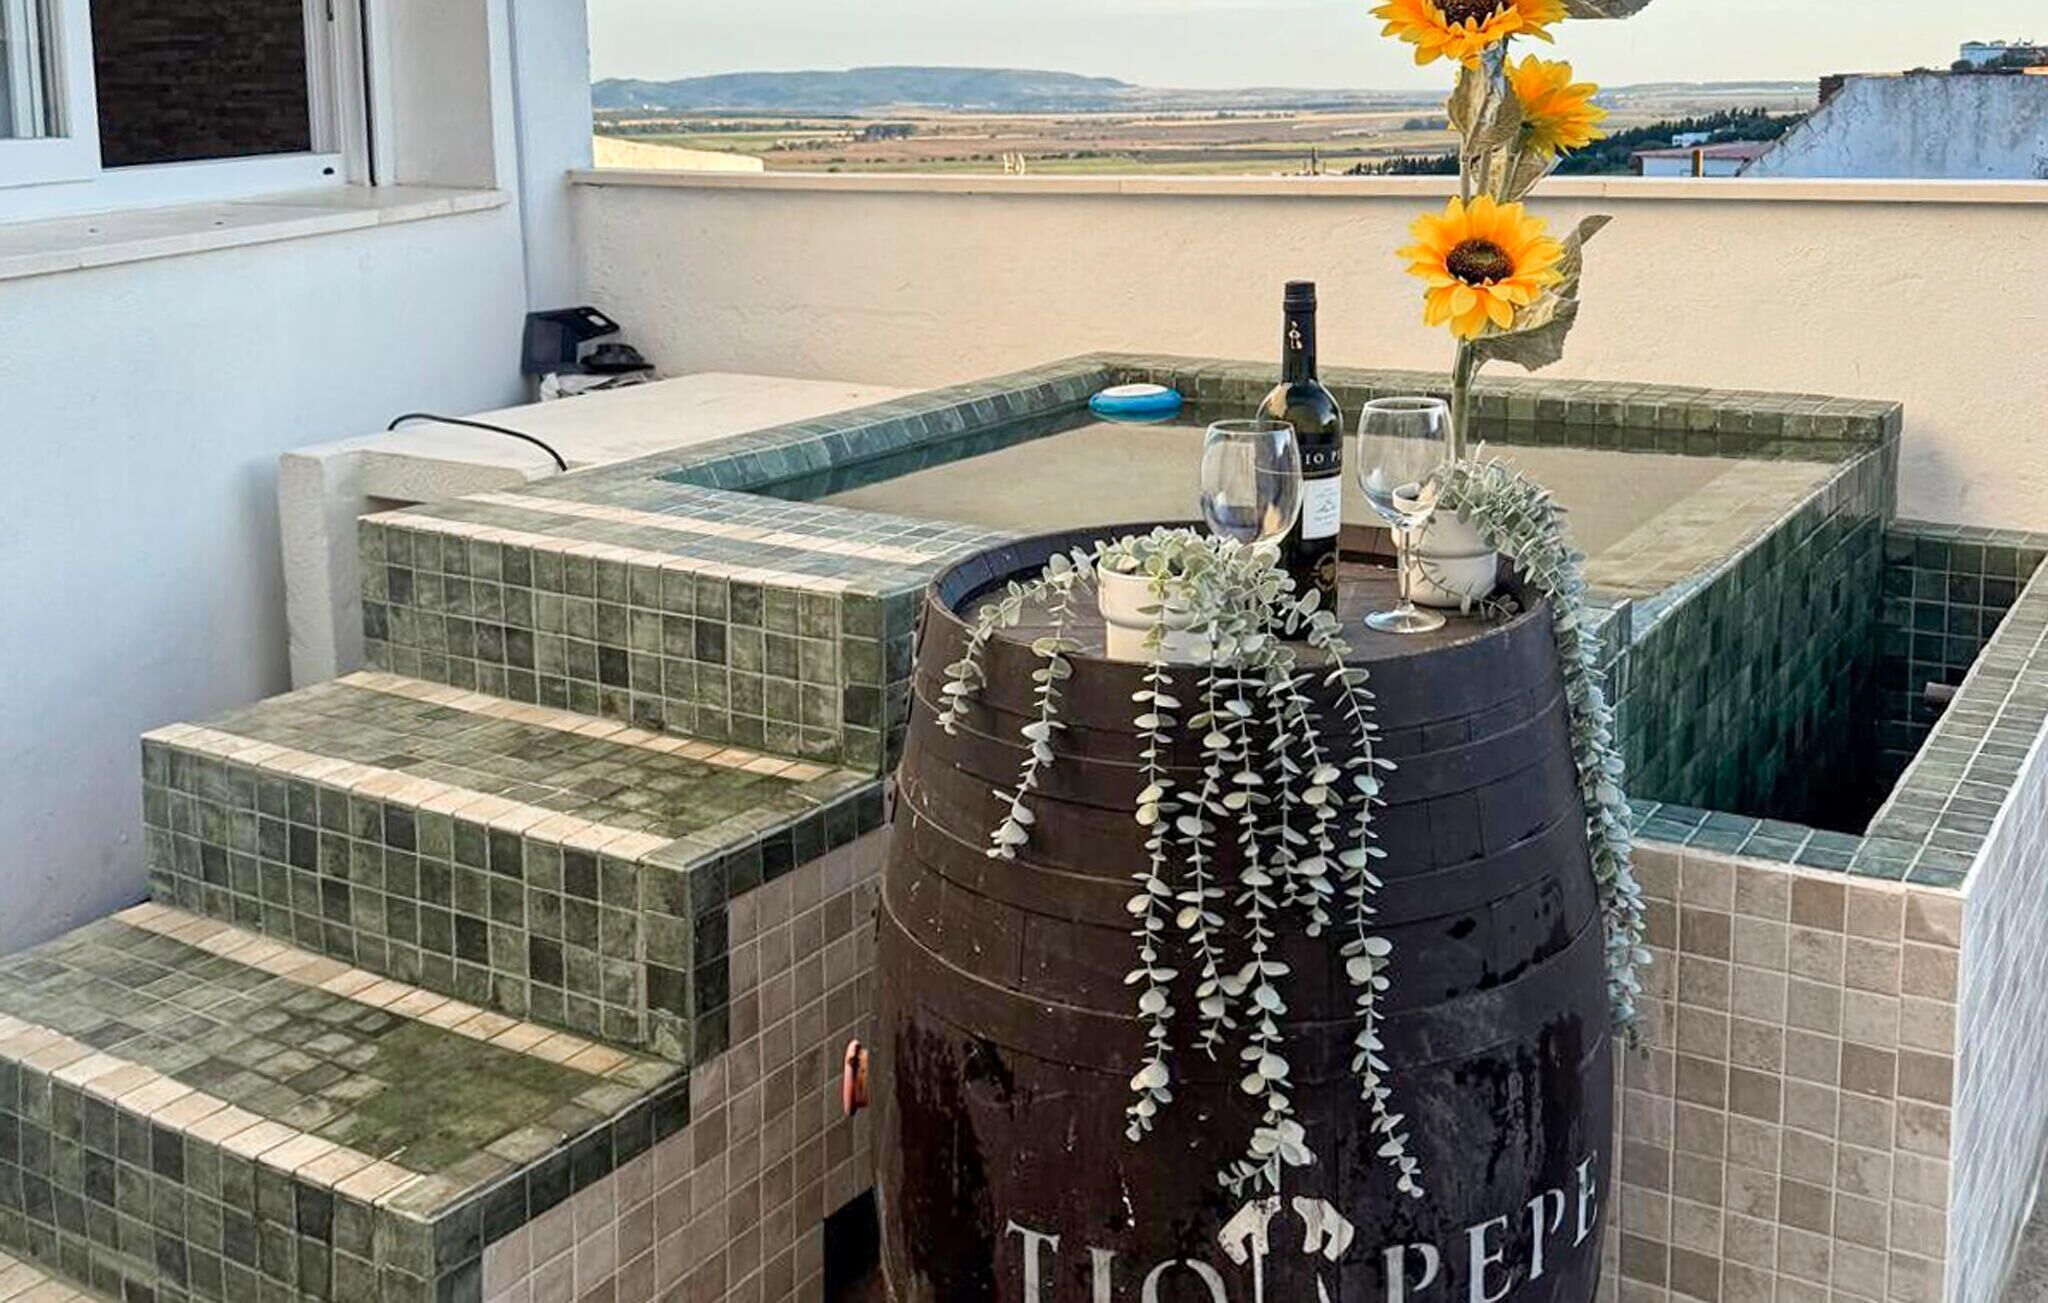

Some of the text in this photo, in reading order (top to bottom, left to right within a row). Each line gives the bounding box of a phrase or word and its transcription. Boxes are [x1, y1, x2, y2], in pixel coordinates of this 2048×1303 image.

[1302, 452, 1325, 465] IO
[1005, 1150, 1598, 1303] TIO PEPE
